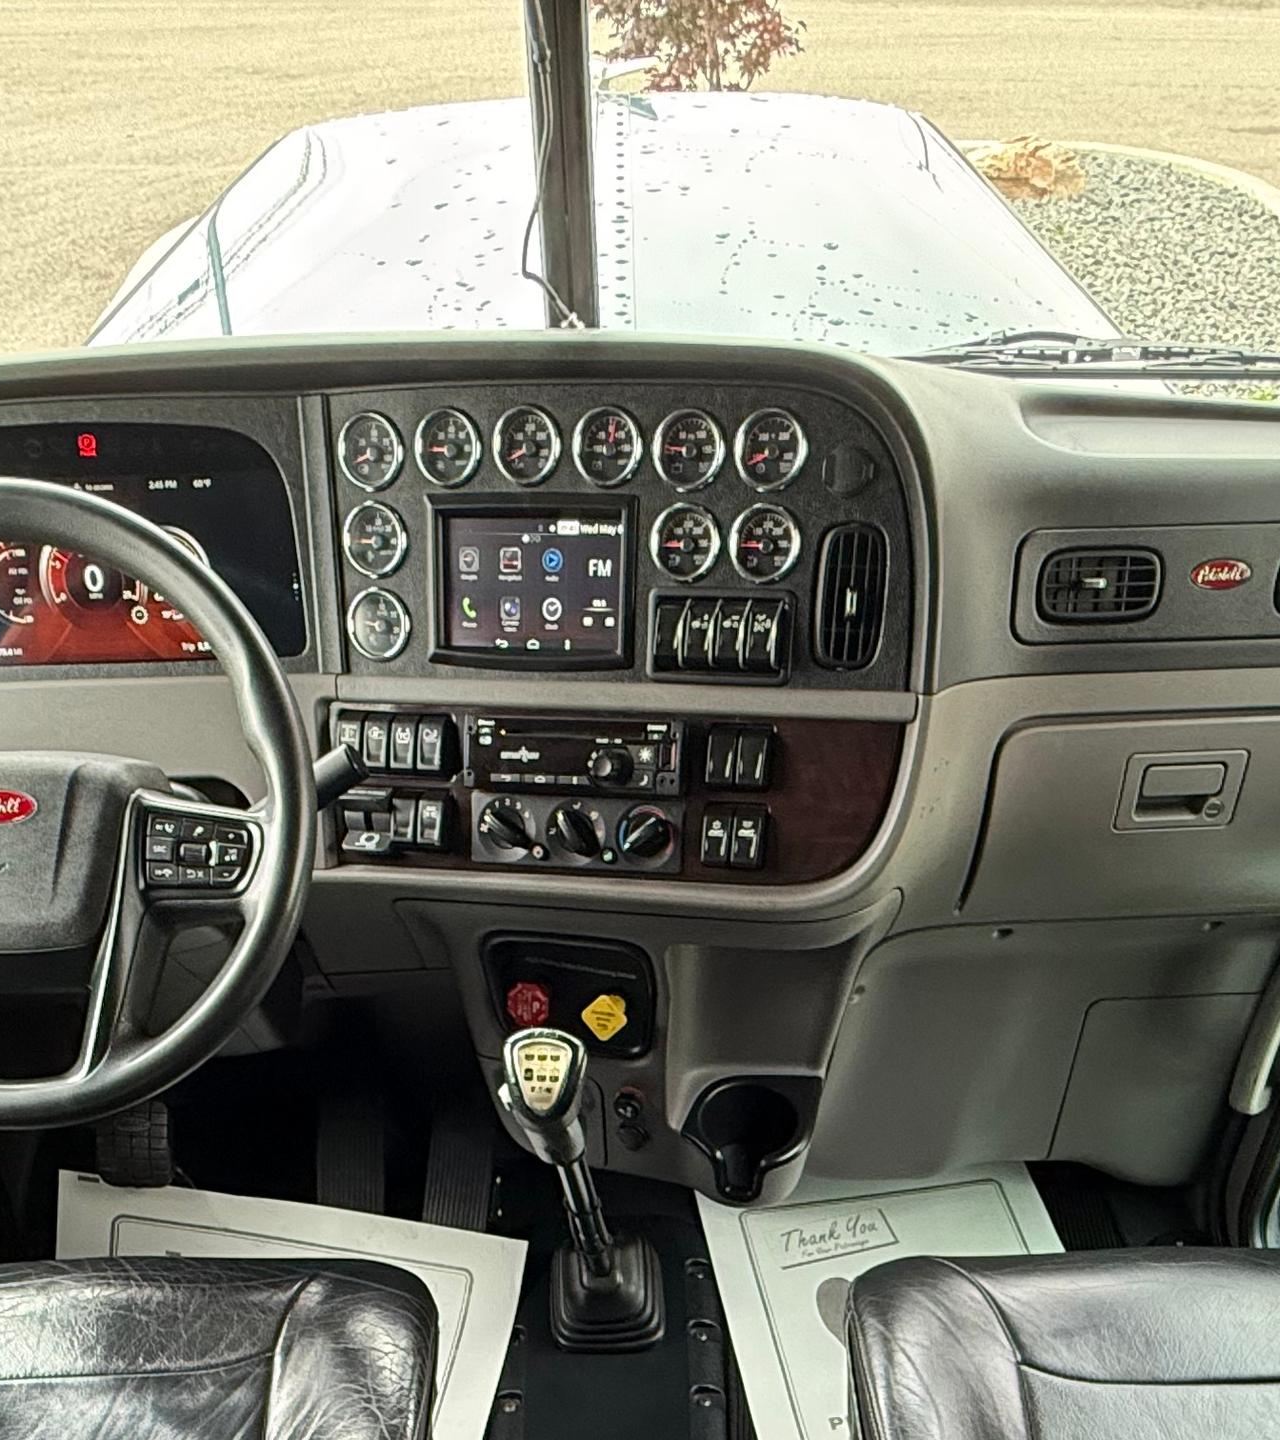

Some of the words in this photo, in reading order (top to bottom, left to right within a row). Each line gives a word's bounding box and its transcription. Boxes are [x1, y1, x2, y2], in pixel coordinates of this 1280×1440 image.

[580, 522, 599, 535] Wed
[599, 523, 617, 537] May
[84, 564, 105, 593] 0
[588, 558, 613, 577] FM
[780, 1220, 841, 1252] Thank
[846, 1214, 878, 1238] You
